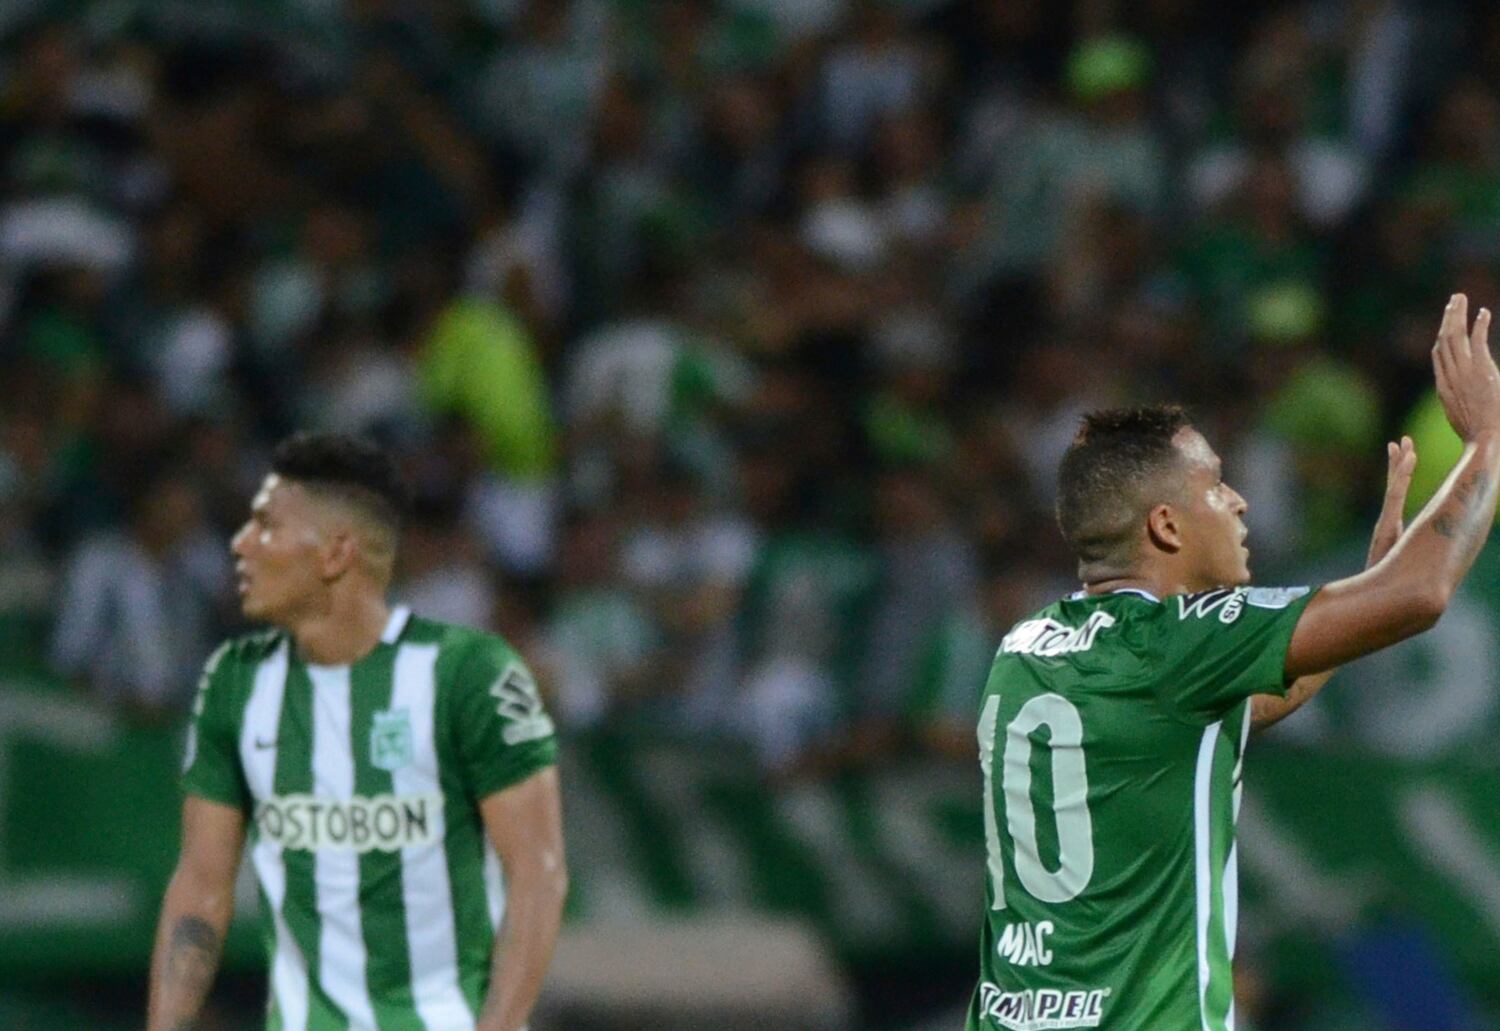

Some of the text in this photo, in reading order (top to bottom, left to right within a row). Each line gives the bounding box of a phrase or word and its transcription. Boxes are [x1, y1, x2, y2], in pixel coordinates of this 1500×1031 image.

[262, 800, 428, 844] OSTOBON
[977, 692, 1094, 910] 10
[997, 920, 1054, 967] MAC
